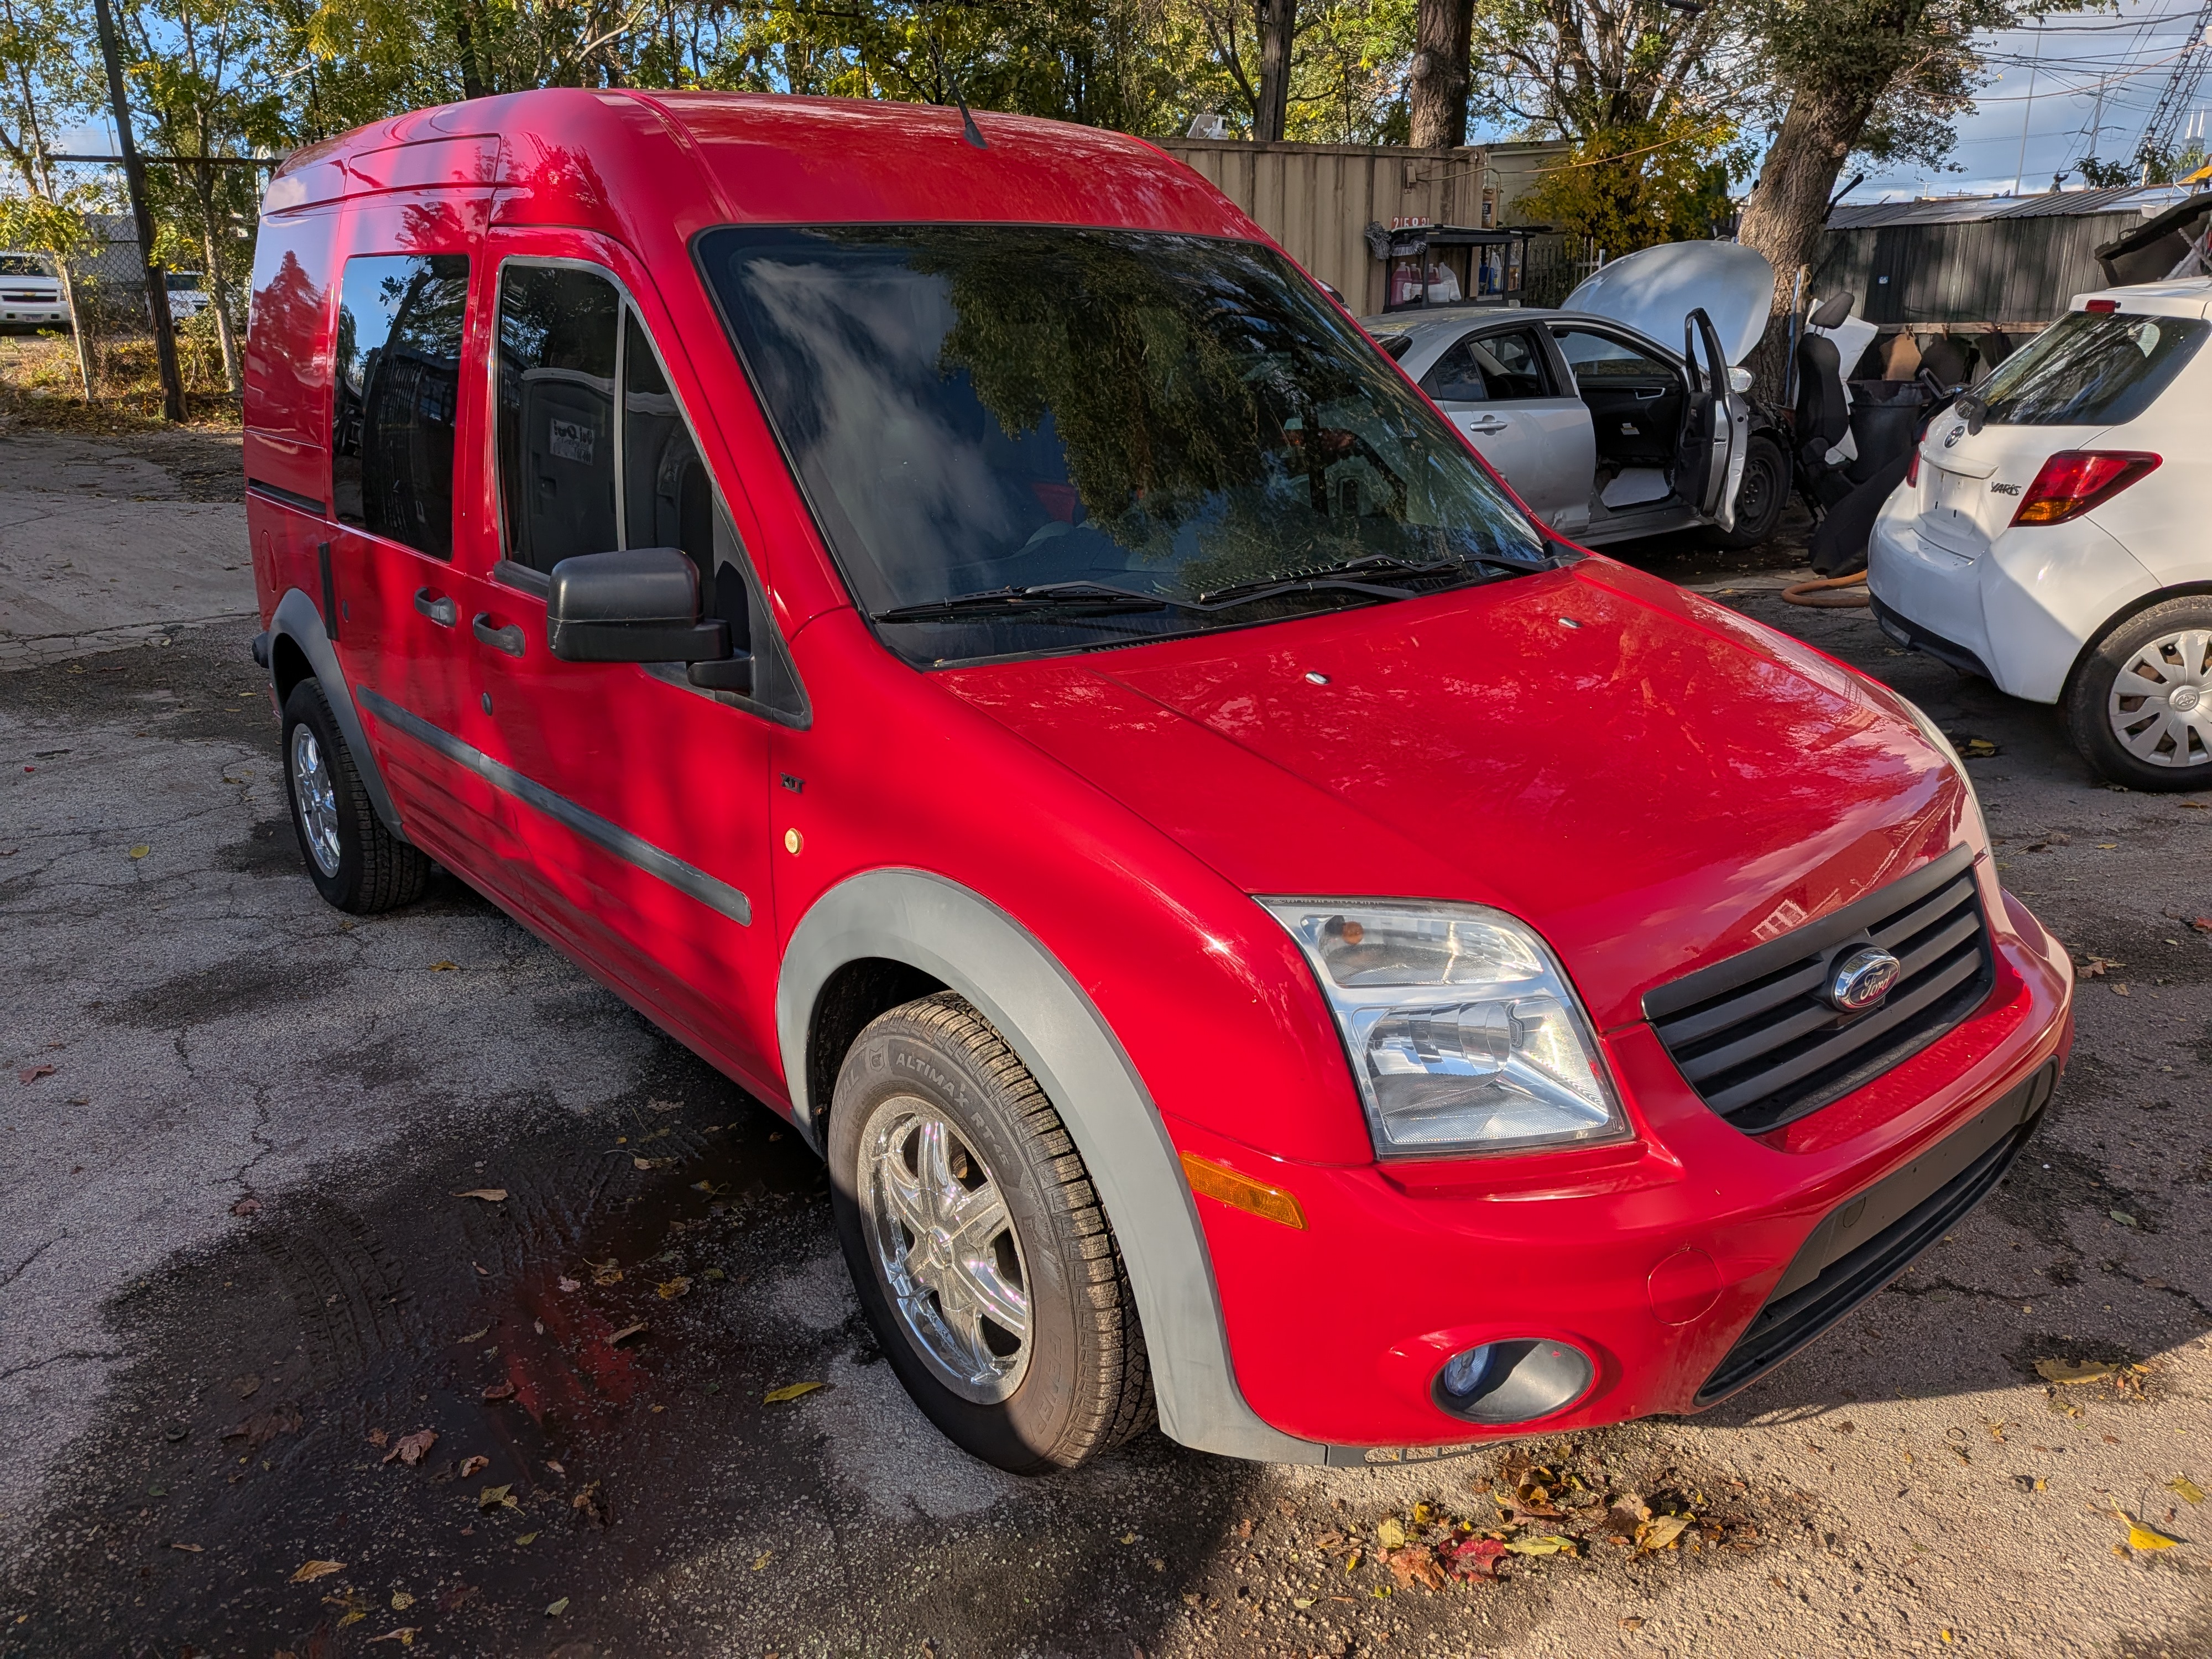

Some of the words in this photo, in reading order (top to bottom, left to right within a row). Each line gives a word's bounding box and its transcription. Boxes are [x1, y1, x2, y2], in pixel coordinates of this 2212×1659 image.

[1990, 482, 2022, 496] YARIS
[780, 773, 805, 794] XLT
[1860, 968, 1891, 1000] Ford
[896, 1053, 969, 1108] ALTIMAX
